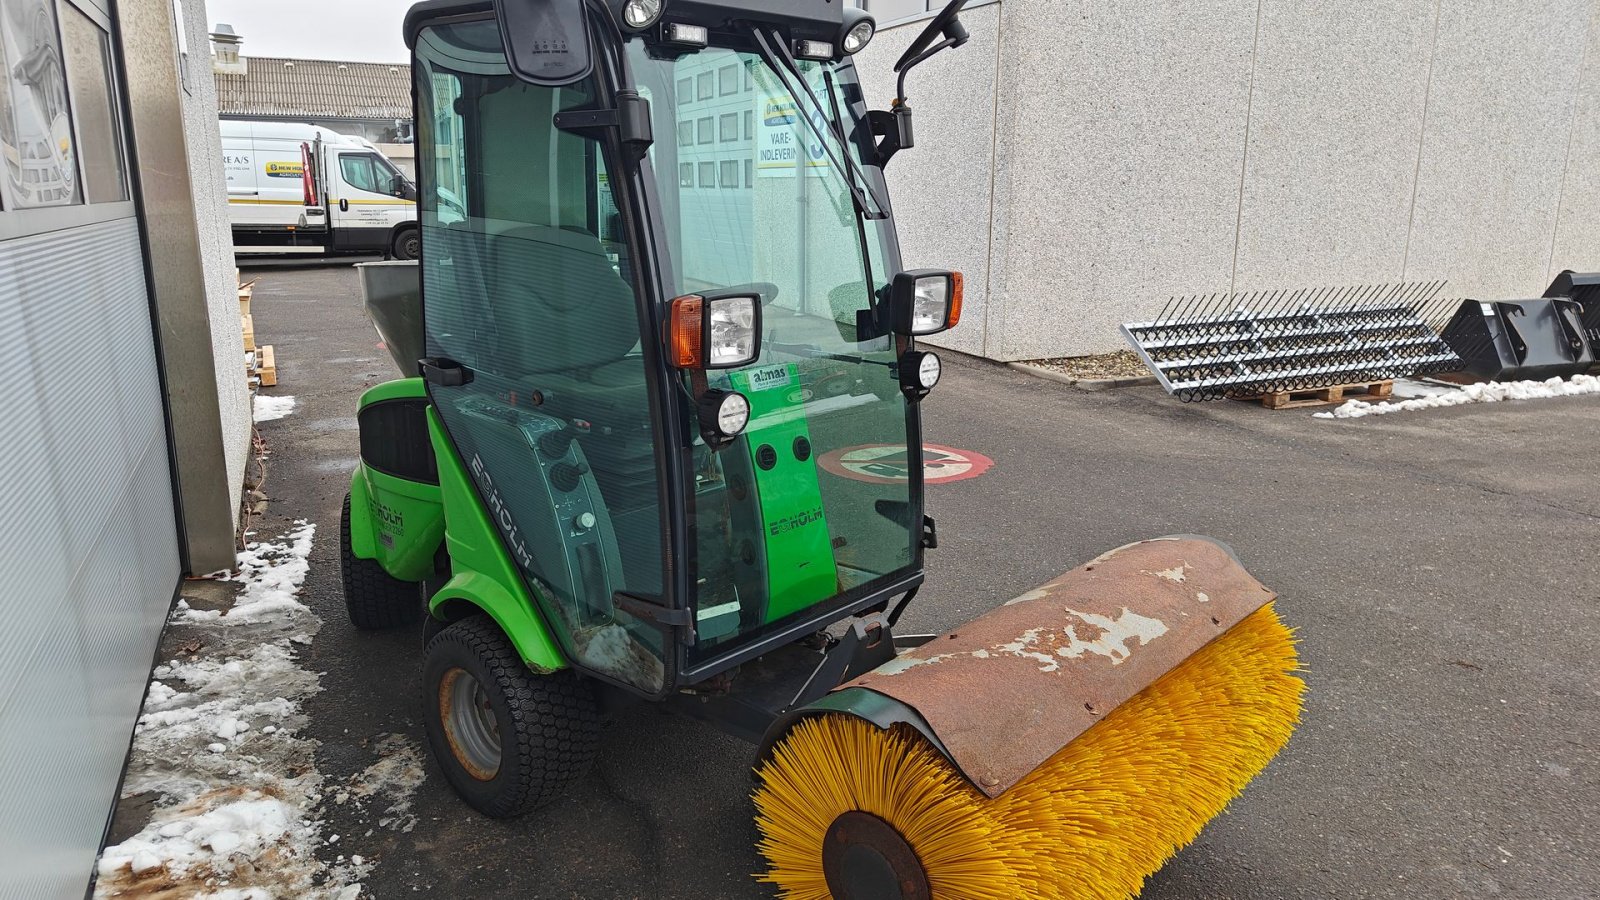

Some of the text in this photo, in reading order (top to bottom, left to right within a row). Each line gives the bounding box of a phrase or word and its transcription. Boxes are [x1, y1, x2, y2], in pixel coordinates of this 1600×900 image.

[771, 132, 792, 145] VARE-
[811, 109, 825, 160] 3
[222, 156, 249, 164] RE A/S
[760, 148, 796, 161] INDLEVERIN
[753, 367, 786, 384] almas
[471, 453, 533, 568] EGHOLM
[769, 506, 823, 536] EGHOLM
